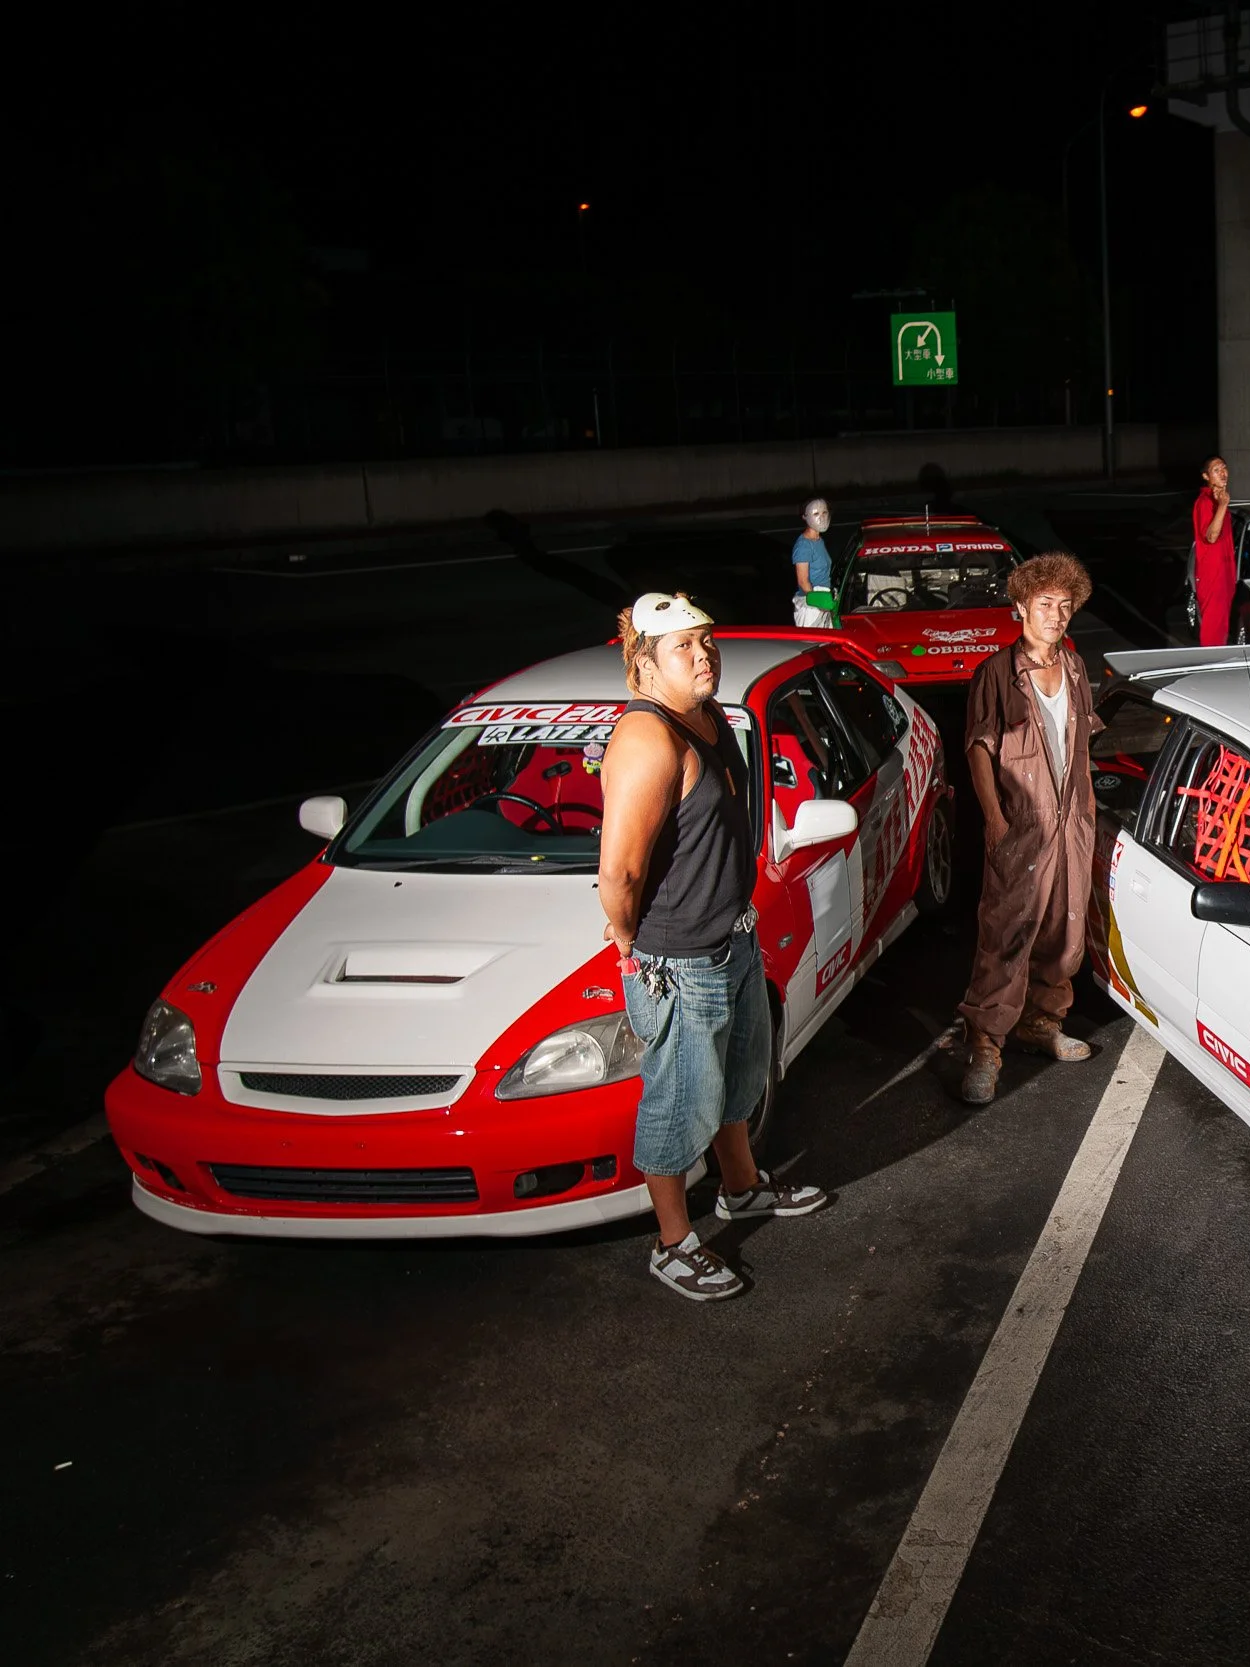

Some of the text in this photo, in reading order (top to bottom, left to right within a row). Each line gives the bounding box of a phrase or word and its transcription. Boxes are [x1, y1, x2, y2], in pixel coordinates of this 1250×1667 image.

[904, 349, 931, 360] 大型車
[927, 367, 954, 380] 小型車
[865, 545, 933, 554] HONDA
[928, 644, 999, 654] OBERON
[452, 707, 561, 723] CIVIC
[1203, 1029, 1248, 1078] CIVIC
